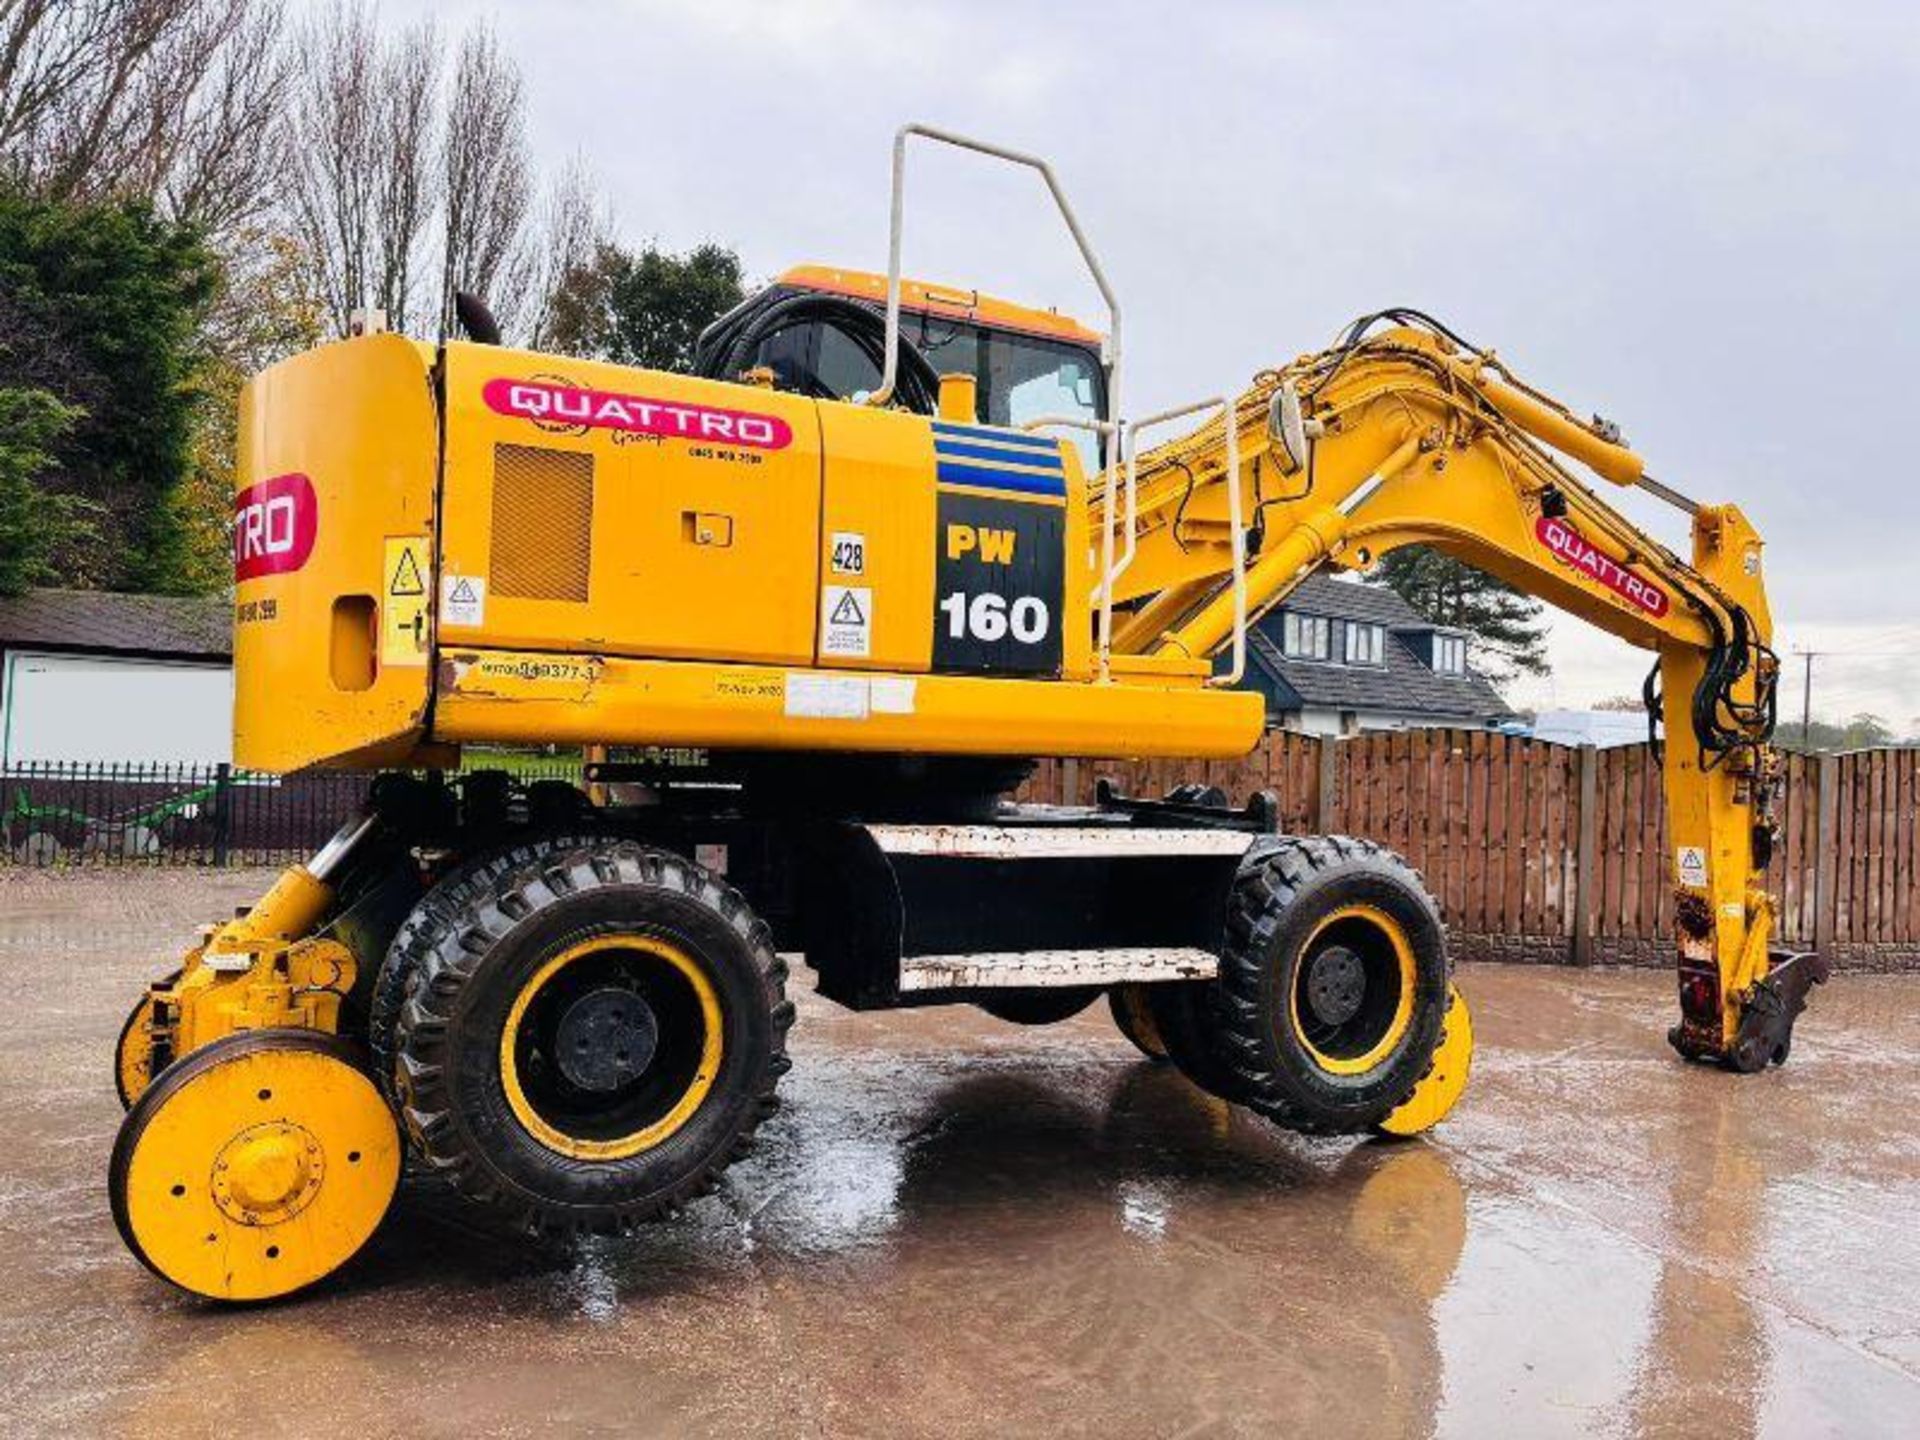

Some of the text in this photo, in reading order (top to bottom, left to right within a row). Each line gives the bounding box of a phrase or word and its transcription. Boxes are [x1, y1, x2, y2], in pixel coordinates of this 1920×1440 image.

[510, 386, 774, 443] QUATTRO
[832, 542, 863, 571] 428
[947, 524, 1016, 565] PW
[1545, 524, 1661, 610] QUATTRO
[940, 592, 1049, 644] 160
